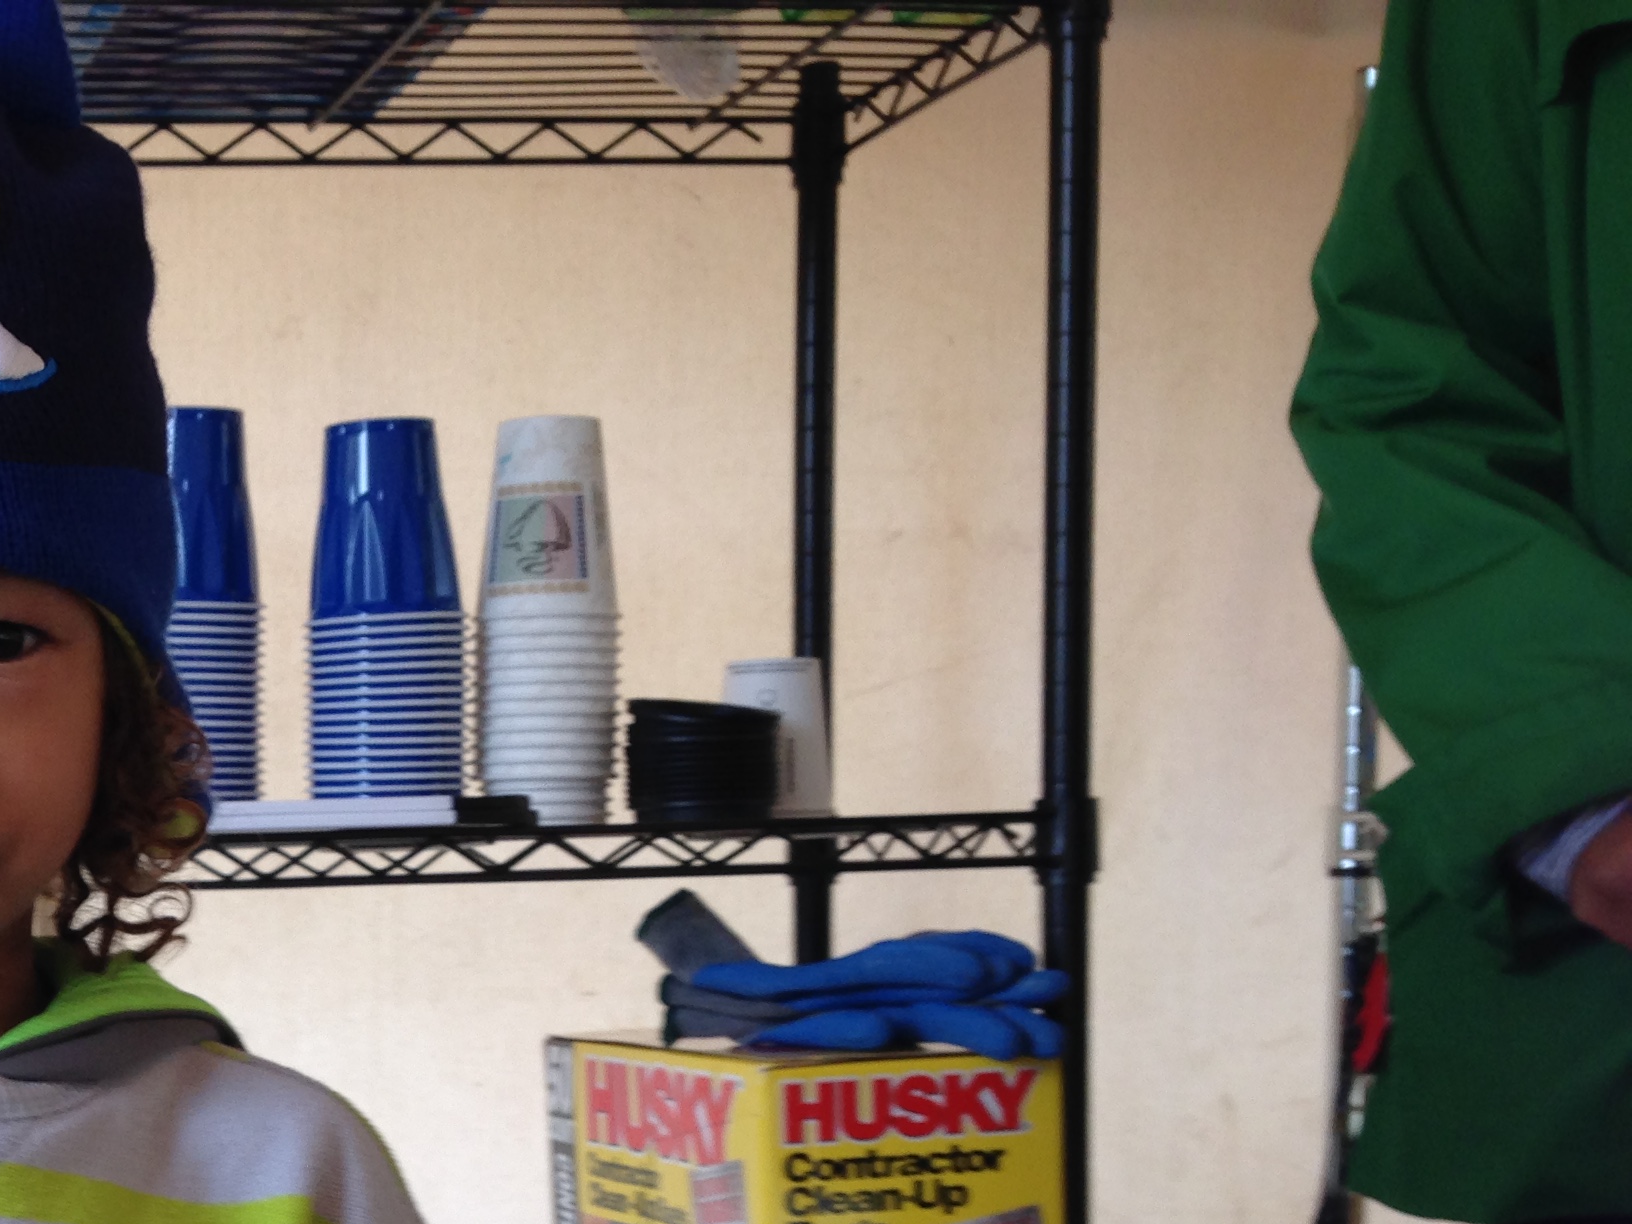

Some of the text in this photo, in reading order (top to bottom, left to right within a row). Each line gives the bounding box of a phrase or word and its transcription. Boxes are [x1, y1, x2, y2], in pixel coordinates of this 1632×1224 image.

[584, 1055, 745, 1168] HUSKY
[781, 1067, 1039, 1146] HUSKY
[784, 1146, 1006, 1182] Contractor
[784, 1178, 969, 1215] Clean-Up
